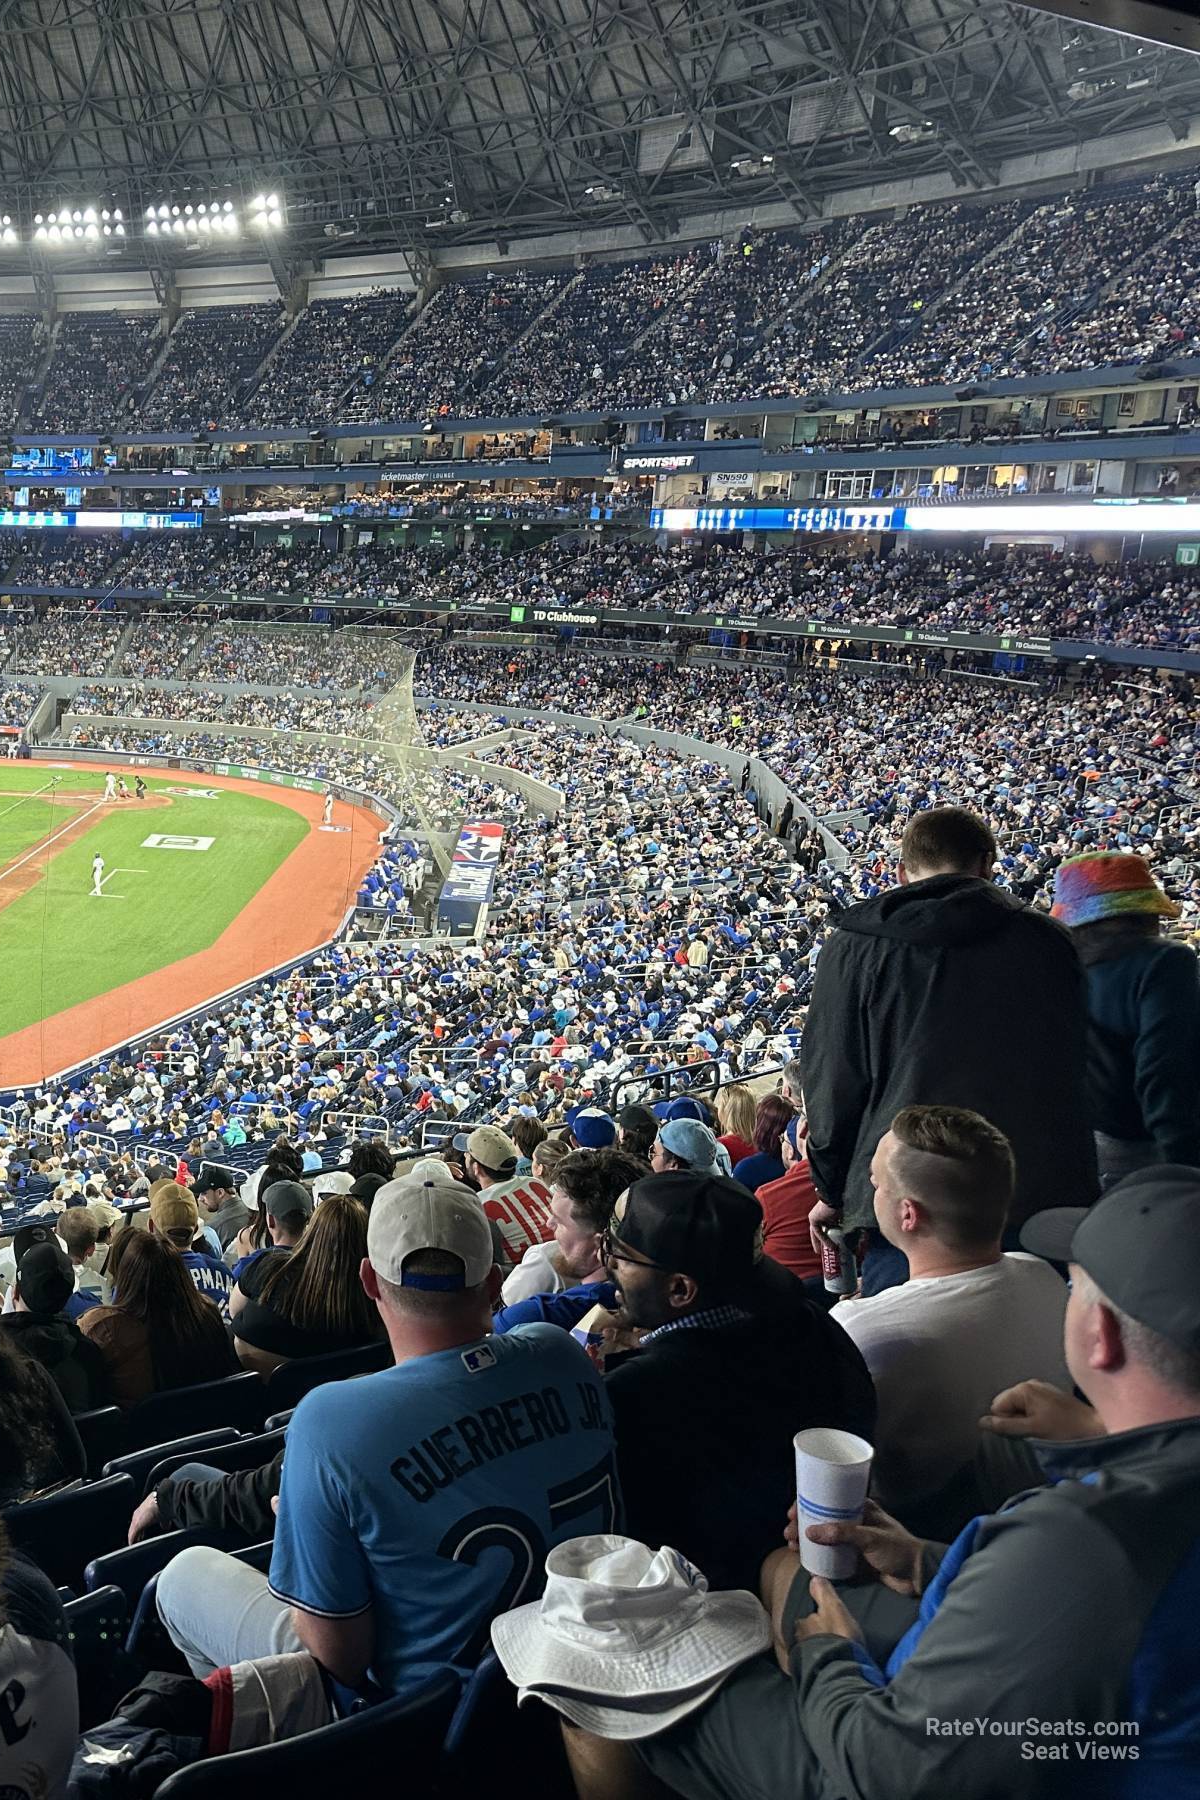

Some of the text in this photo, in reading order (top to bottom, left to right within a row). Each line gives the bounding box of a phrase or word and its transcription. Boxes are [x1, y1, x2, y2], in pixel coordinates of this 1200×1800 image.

[623, 456, 695, 469] SPORTSNET
[381, 472, 425, 481] ticketmaster
[717, 473, 748, 481] SN590
[1178, 548, 1197, 564] TD
[533, 610, 546, 620] TD
[547, 611, 597, 624] Clubhouse
[390, 1386, 570, 1503] GUERRERO
